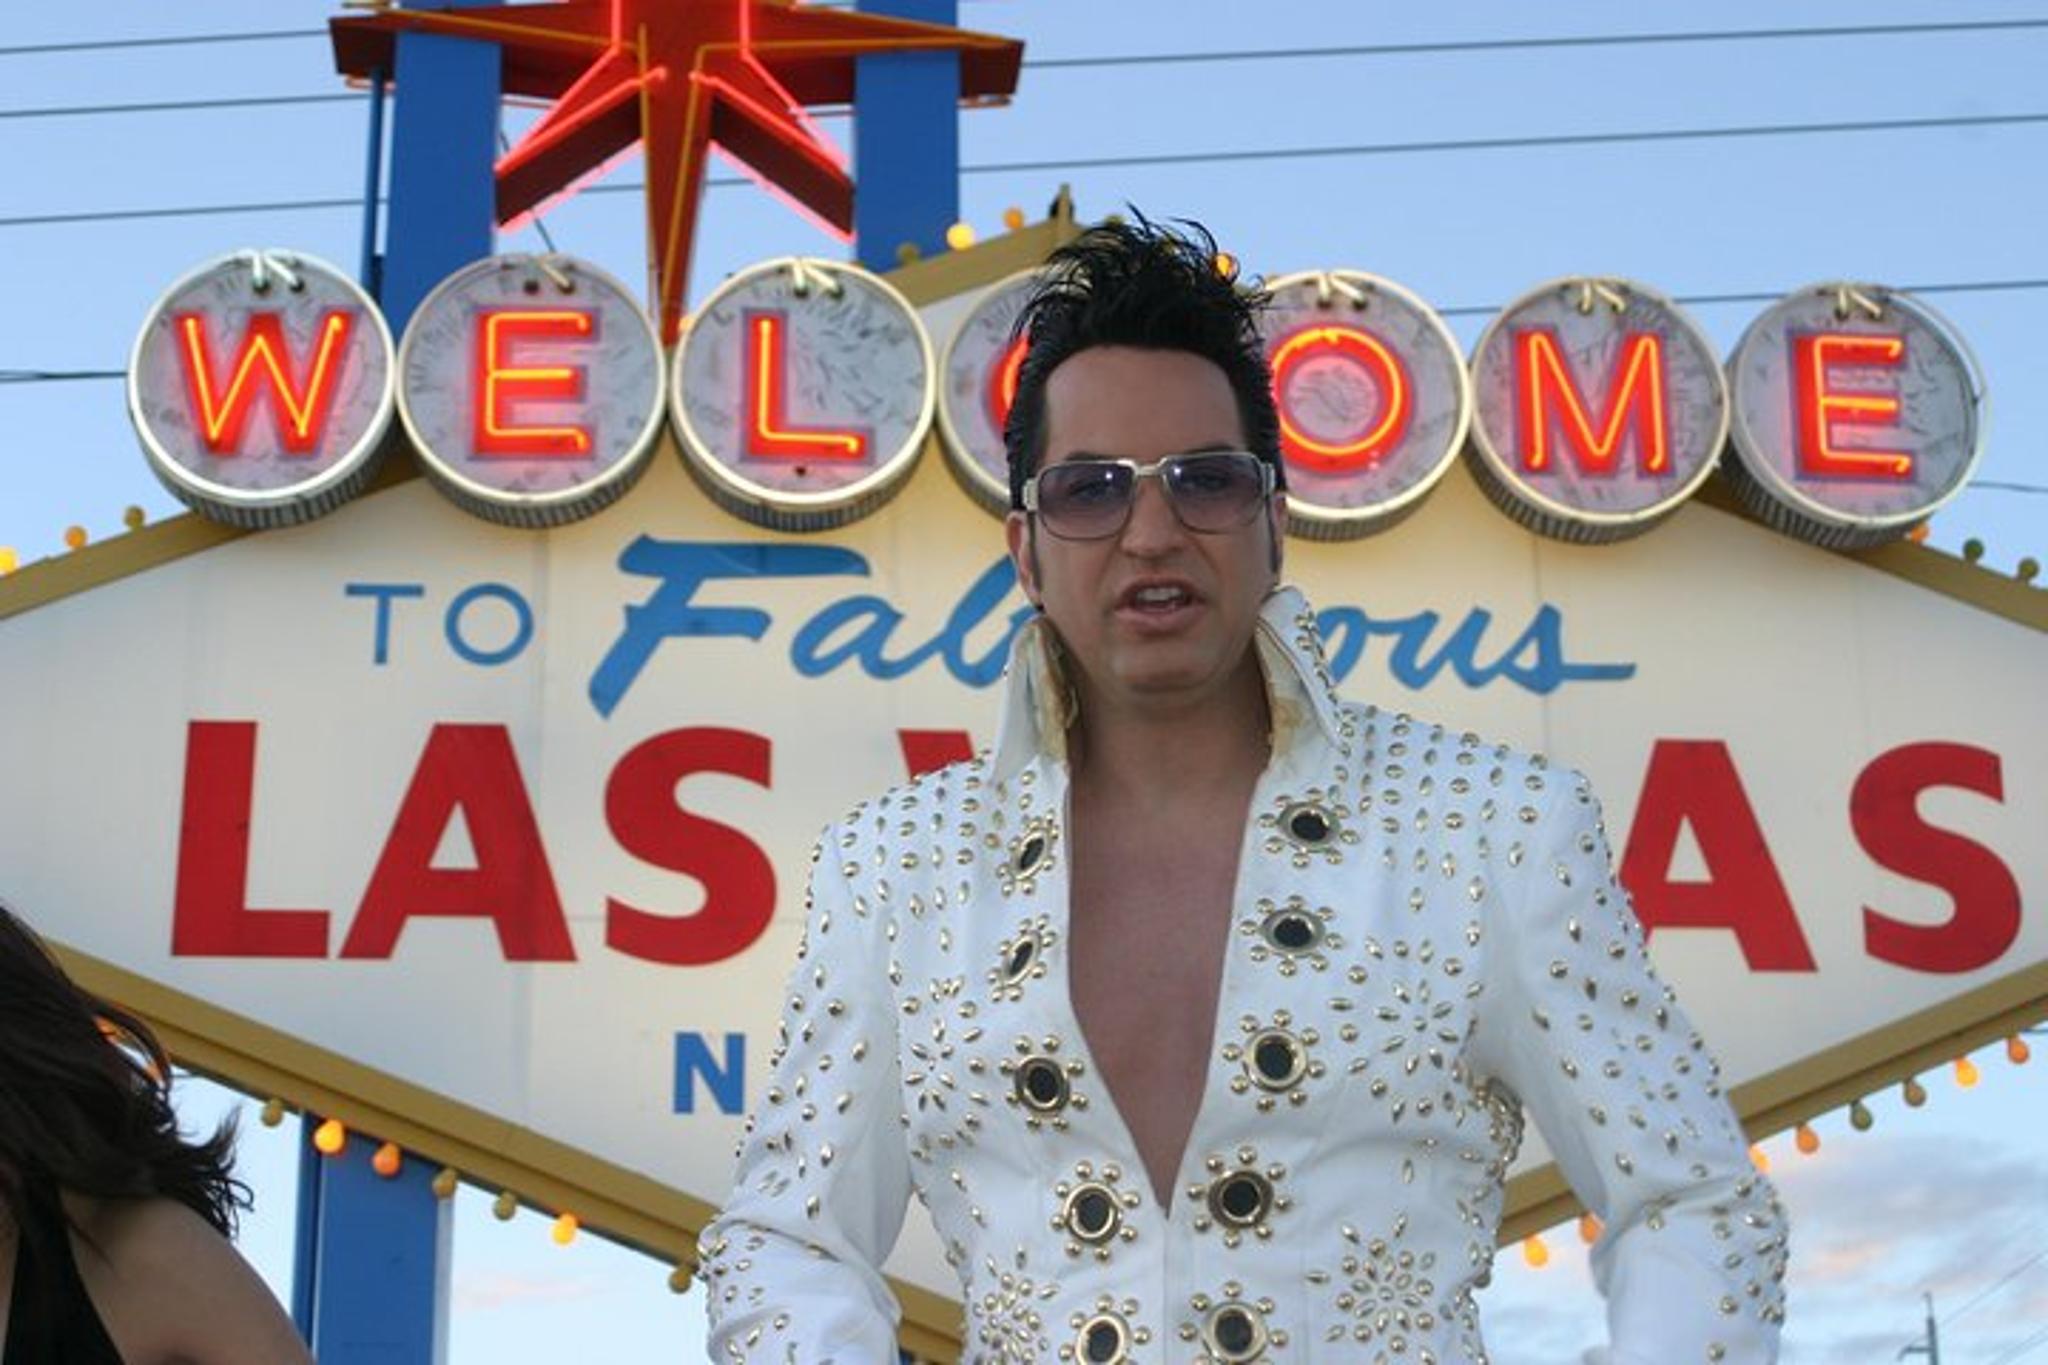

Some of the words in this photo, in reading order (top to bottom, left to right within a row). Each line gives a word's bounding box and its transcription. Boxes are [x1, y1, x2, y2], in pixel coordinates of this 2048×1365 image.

[172, 304, 1918, 484] WELOME
[344, 582, 534, 667] TO
[588, 533, 1636, 718] Fabous
[171, 719, 778, 968] LAS
